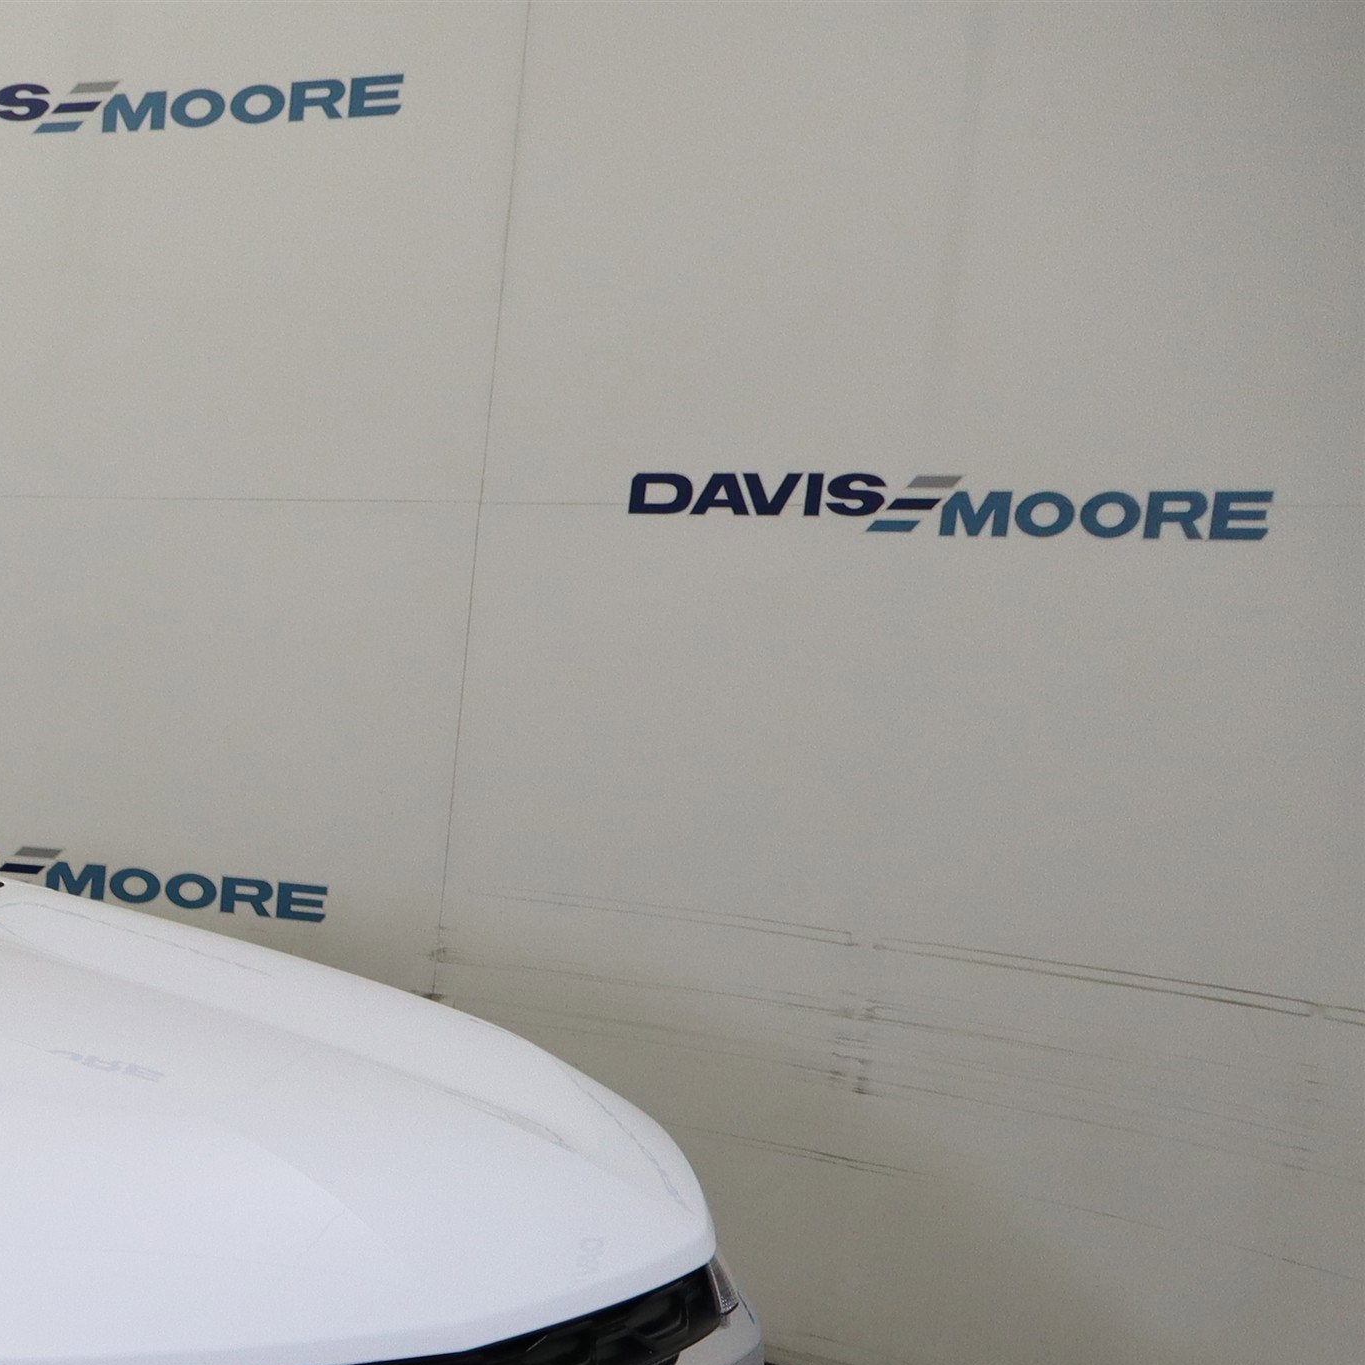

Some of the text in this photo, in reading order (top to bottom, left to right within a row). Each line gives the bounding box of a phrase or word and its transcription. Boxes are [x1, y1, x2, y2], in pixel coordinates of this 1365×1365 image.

[101, 74, 405, 133] MOORE
[627, 472, 1275, 541] DAVIS MOORE
[46, 860, 328, 923] MOORE
